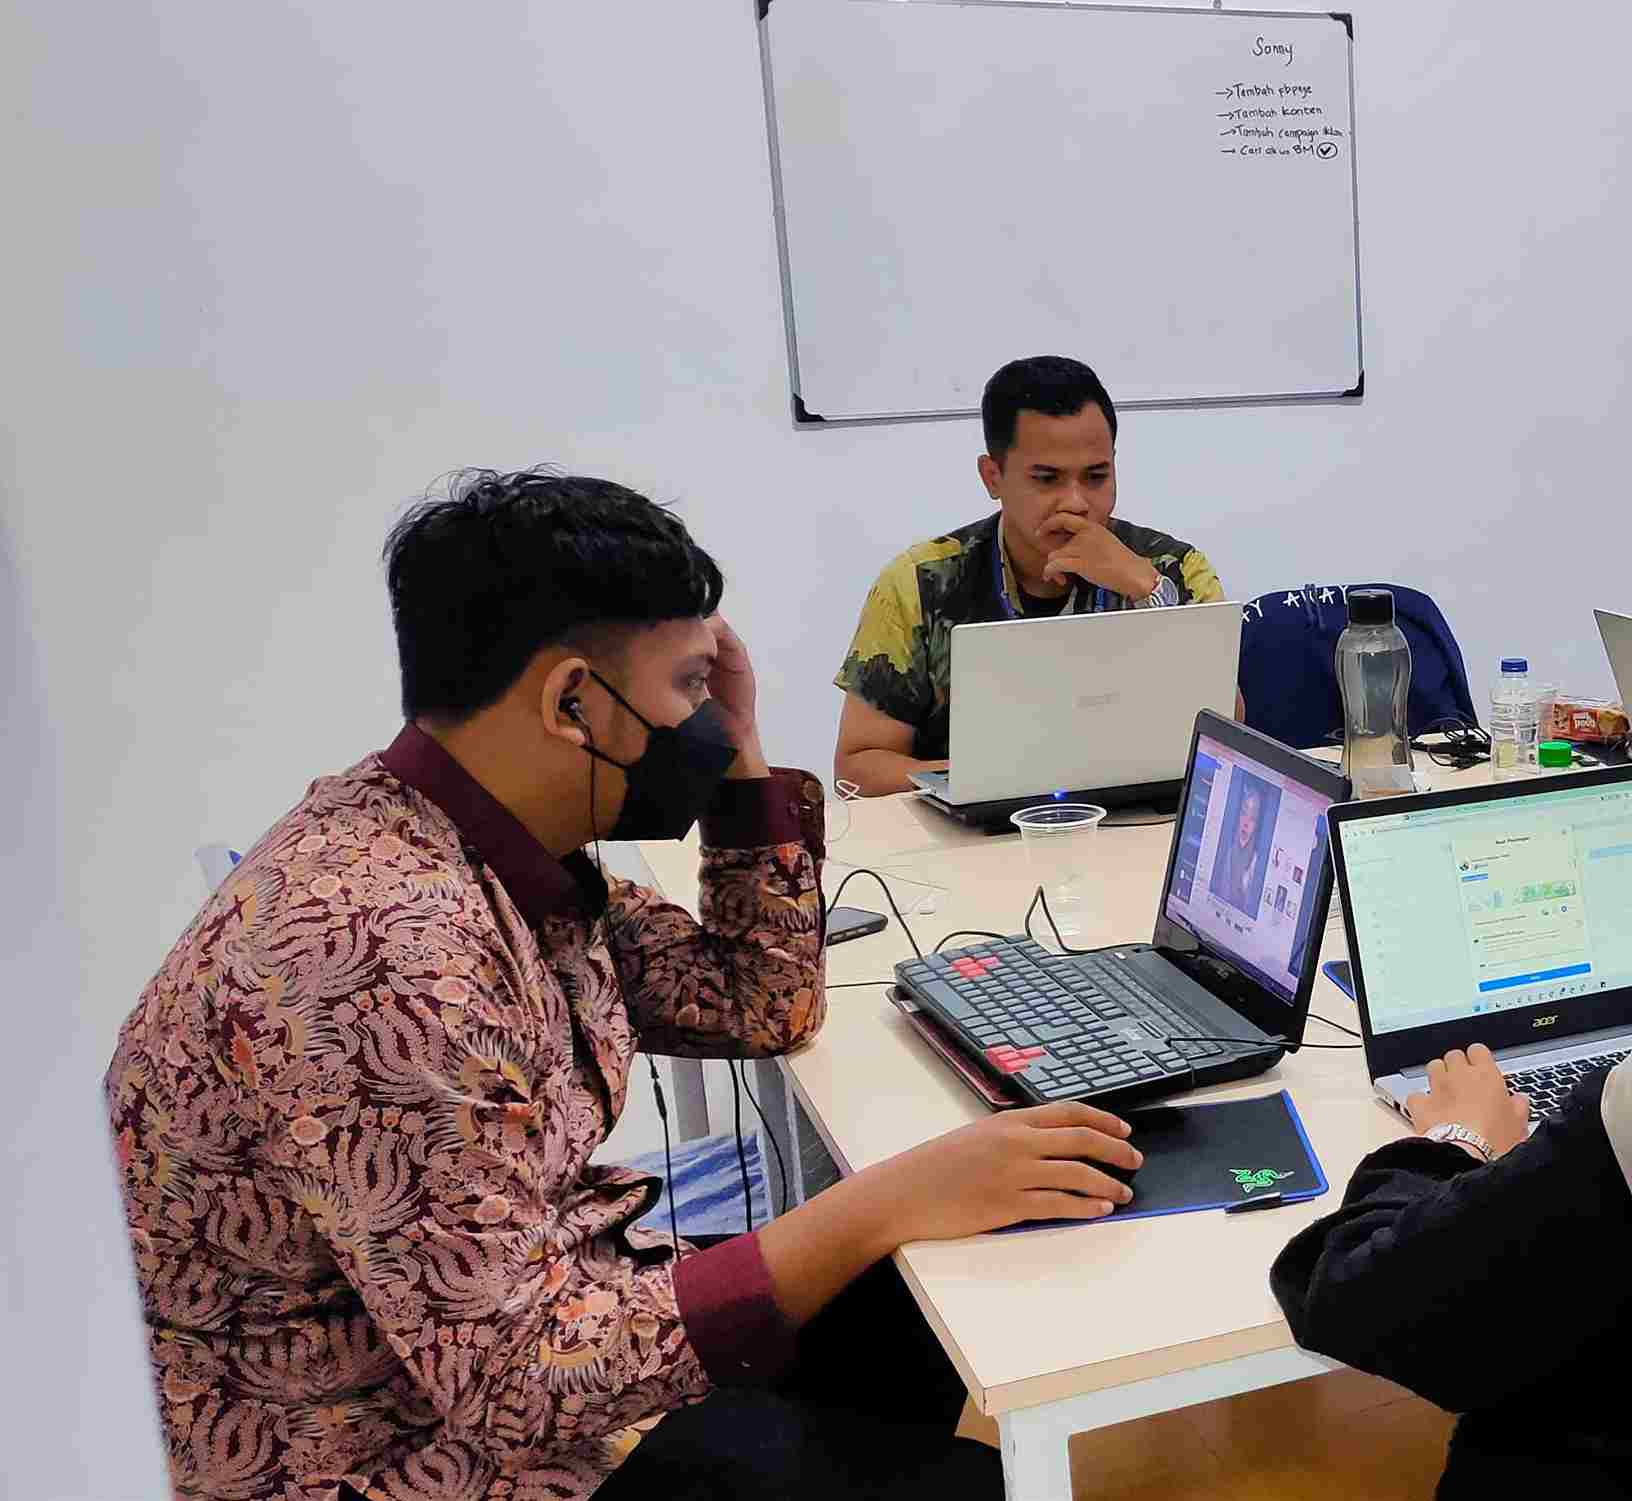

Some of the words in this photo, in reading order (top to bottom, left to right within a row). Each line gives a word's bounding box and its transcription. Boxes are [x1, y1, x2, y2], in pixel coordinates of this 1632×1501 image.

[1252, 36, 1293, 67] Sonny
[1233, 108, 1277, 119] Tambah
[1292, 144, 1315, 156] BM
[1532, 1014, 1559, 1028] acer
